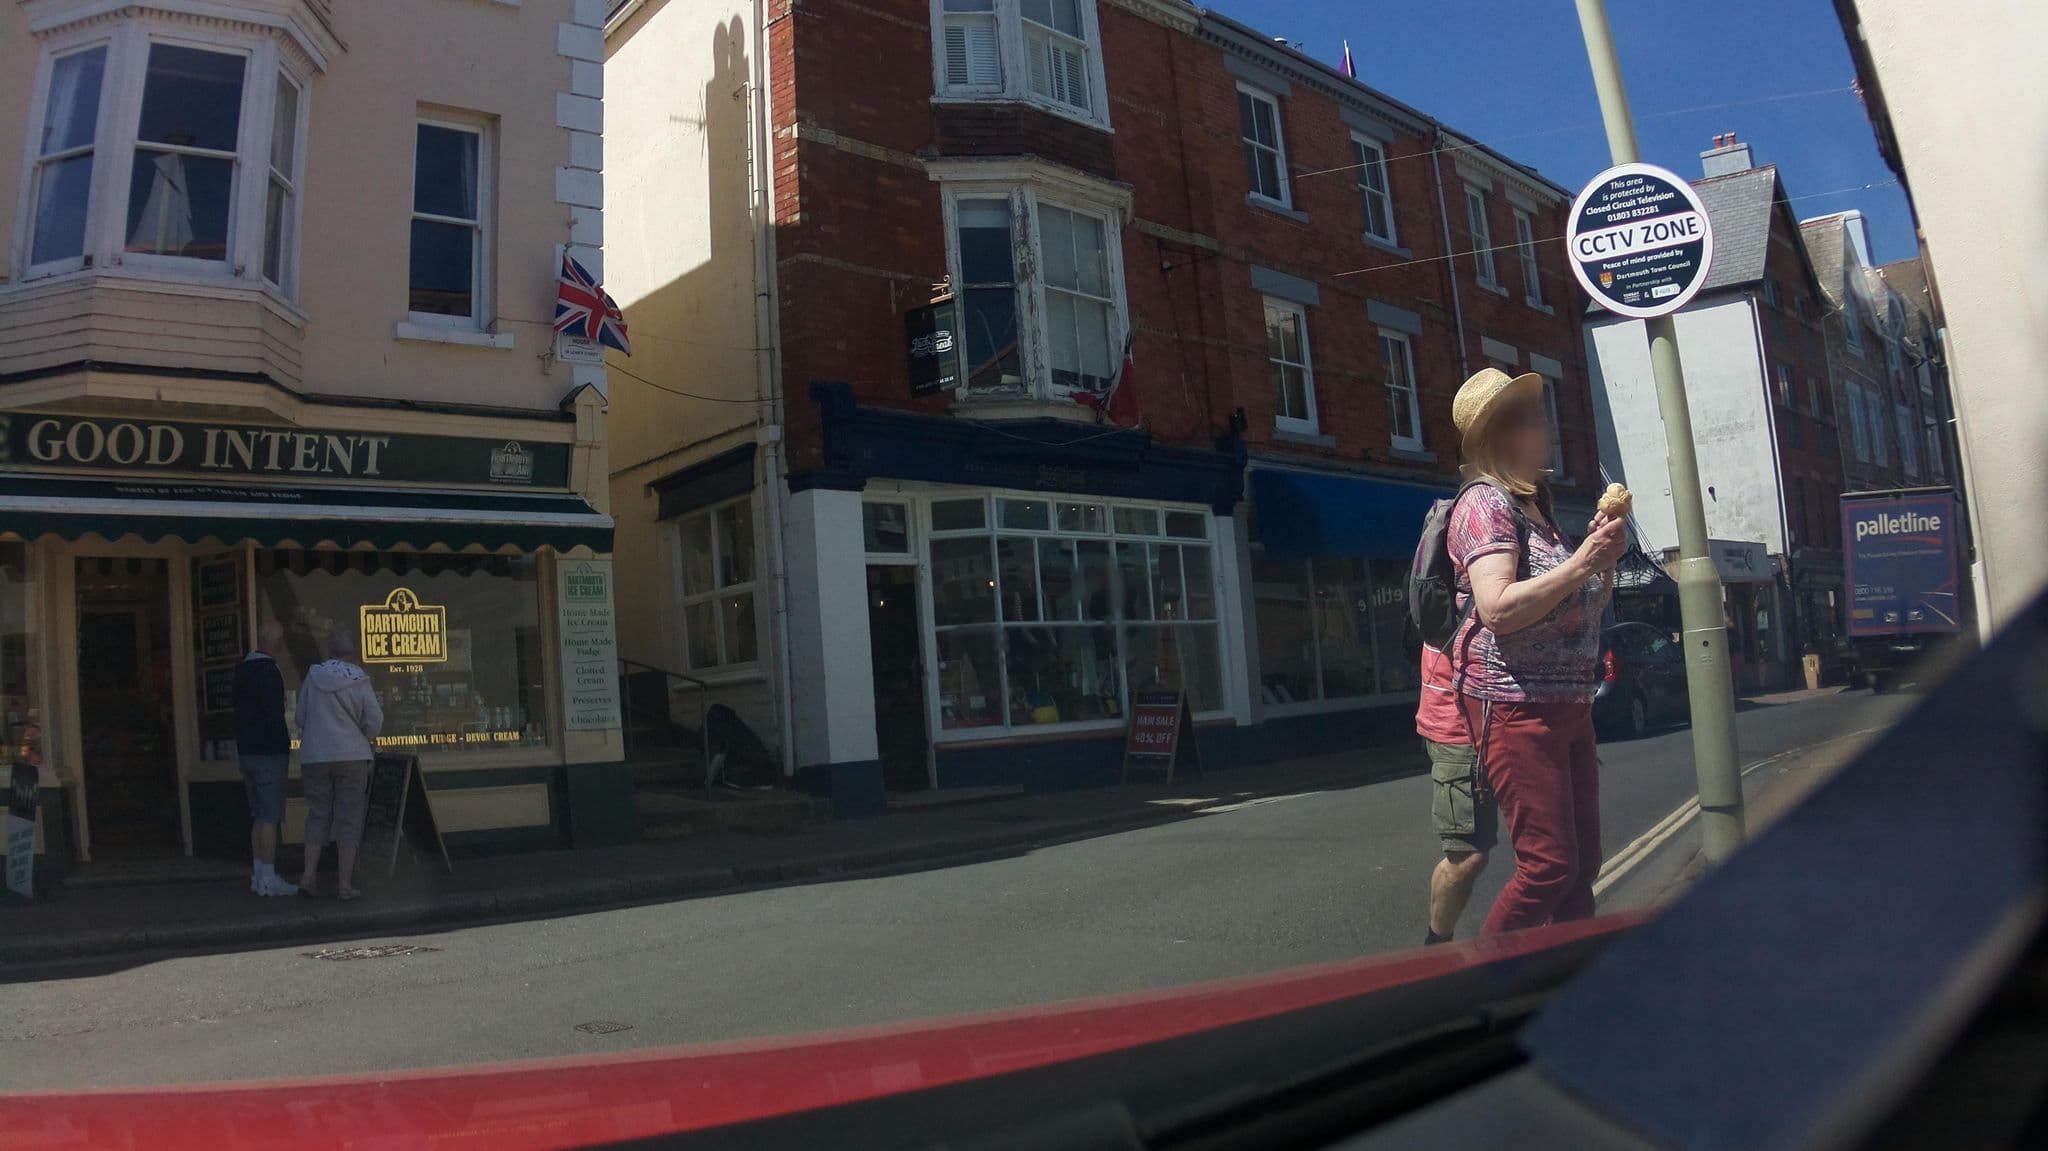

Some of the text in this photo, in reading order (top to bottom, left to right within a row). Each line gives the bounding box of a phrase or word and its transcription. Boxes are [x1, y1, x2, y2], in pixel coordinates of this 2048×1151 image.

[1611, 177, 1643, 190] This area
[1602, 184, 1656, 201] is protected by
[1586, 191, 1674, 215] Closed Circuit Television
[1607, 204, 1660, 222] 01803 832281
[1579, 217, 1699, 256] CCTV ZONE
[1602, 249, 1684, 270] Peace of mind provided by
[1616, 260, 1691, 280] Dartmouth Town Council
[28, 418, 184, 466] GOOD
[200, 428, 389, 475] INTENT
[1855, 512, 1942, 542] palletline
[567, 585, 603, 596] ICE CREAM
[562, 608, 588, 617] Home
[366, 613, 439, 633] DARTMOUTH
[567, 618, 608, 626] Ice Cream
[367, 633, 441, 656] ICE CREAM
[565, 637, 612, 647] Home Made
[577, 647, 601, 657] Fudge
[406, 664, 424, 673] 1928
[575, 666, 605, 675] Clotted
[577, 677, 604, 685] Cream
[572, 696, 611, 705] Preserves
[376, 734, 428, 747] TRADITIONAL
[430, 733, 457, 744] FUDGE
[466, 732, 491, 743] DEVON
[493, 731, 520, 742] CREAM
